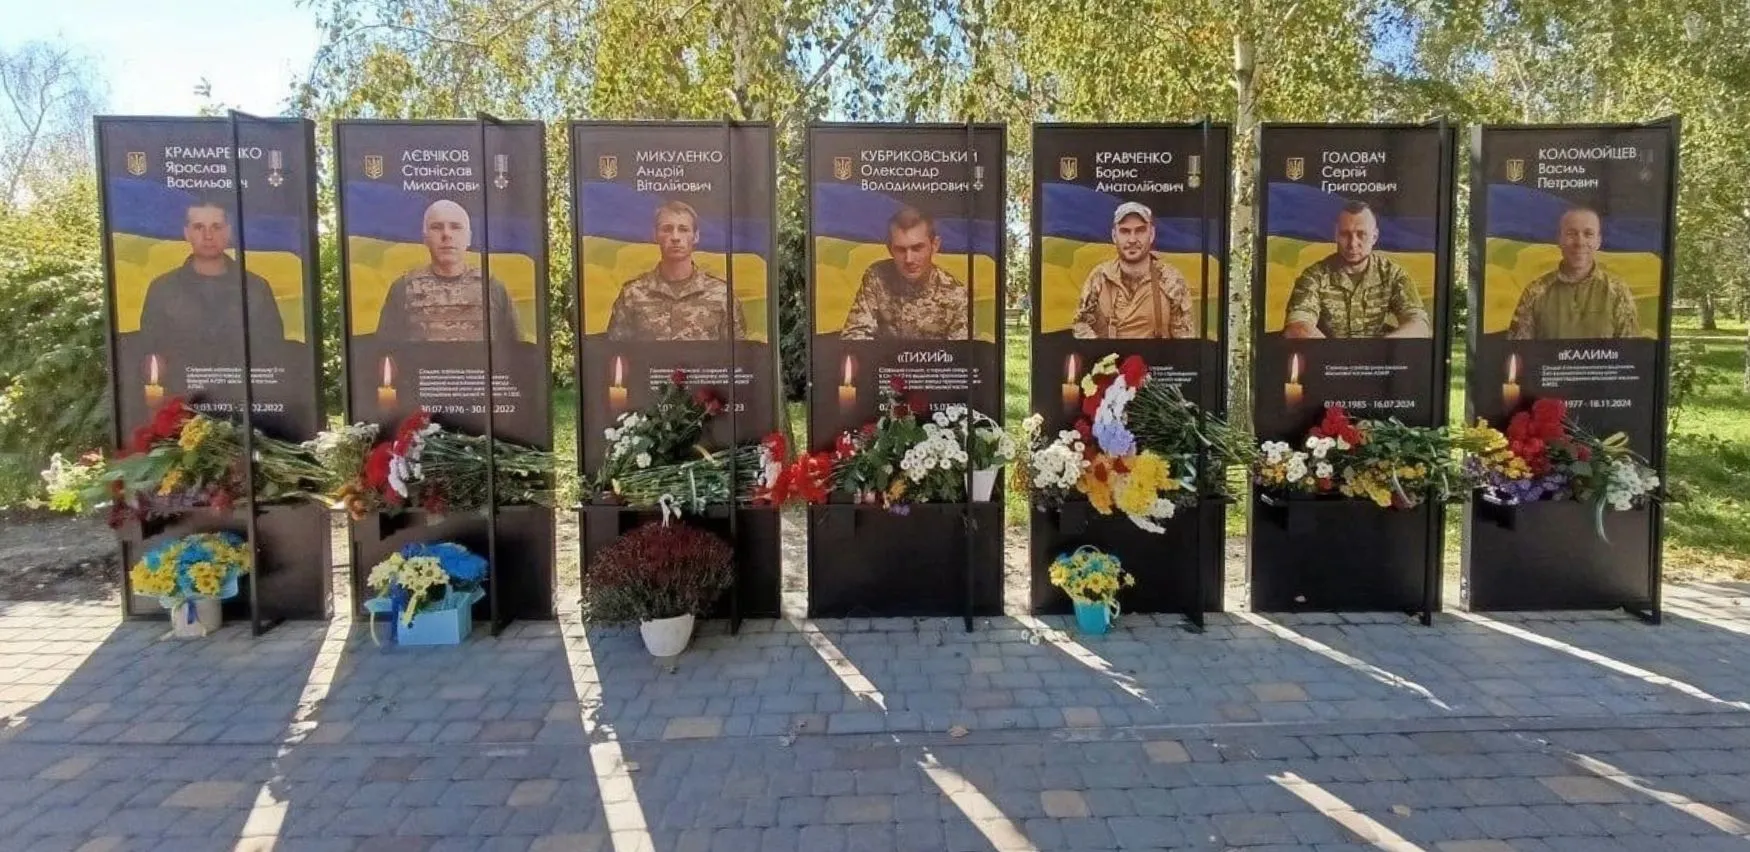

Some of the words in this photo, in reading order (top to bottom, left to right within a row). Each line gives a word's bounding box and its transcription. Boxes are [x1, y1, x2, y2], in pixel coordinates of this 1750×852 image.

[402, 149, 469, 162] ЛЄВЧІКОВ
[636, 150, 723, 163] МИКУЛЕНКО
[1095, 152, 1172, 165] КРАВЧЕНКО
[1322, 151, 1386, 164] ГОЛОВАЧ
[1538, 145, 1638, 161] КОЛОМОЙЦЕВ
[165, 160, 227, 175] Ярослав
[402, 164, 472, 176] Станіслав
[636, 164, 684, 178] Андрій
[861, 164, 940, 179] Олександр
[1095, 166, 1139, 180] Борис
[1322, 166, 1366, 179] Сергій
[1538, 163, 1585, 175] Василь
[167, 176, 249, 189] Васильовч
[403, 179, 480, 191] Михайлови
[636, 178, 712, 192] Віталійович
[861, 179, 969, 193] Володимирович
[1095, 180, 1184, 194] Анатолійович
[1321, 180, 1398, 194] Григорович
[1537, 177, 1599, 190] Петрович
[897, 350, 953, 363] «ТИХИЙ»
[1558, 349, 1619, 361] «КАЛИМ»
[193, 403, 233, 412] 9.03.1973
